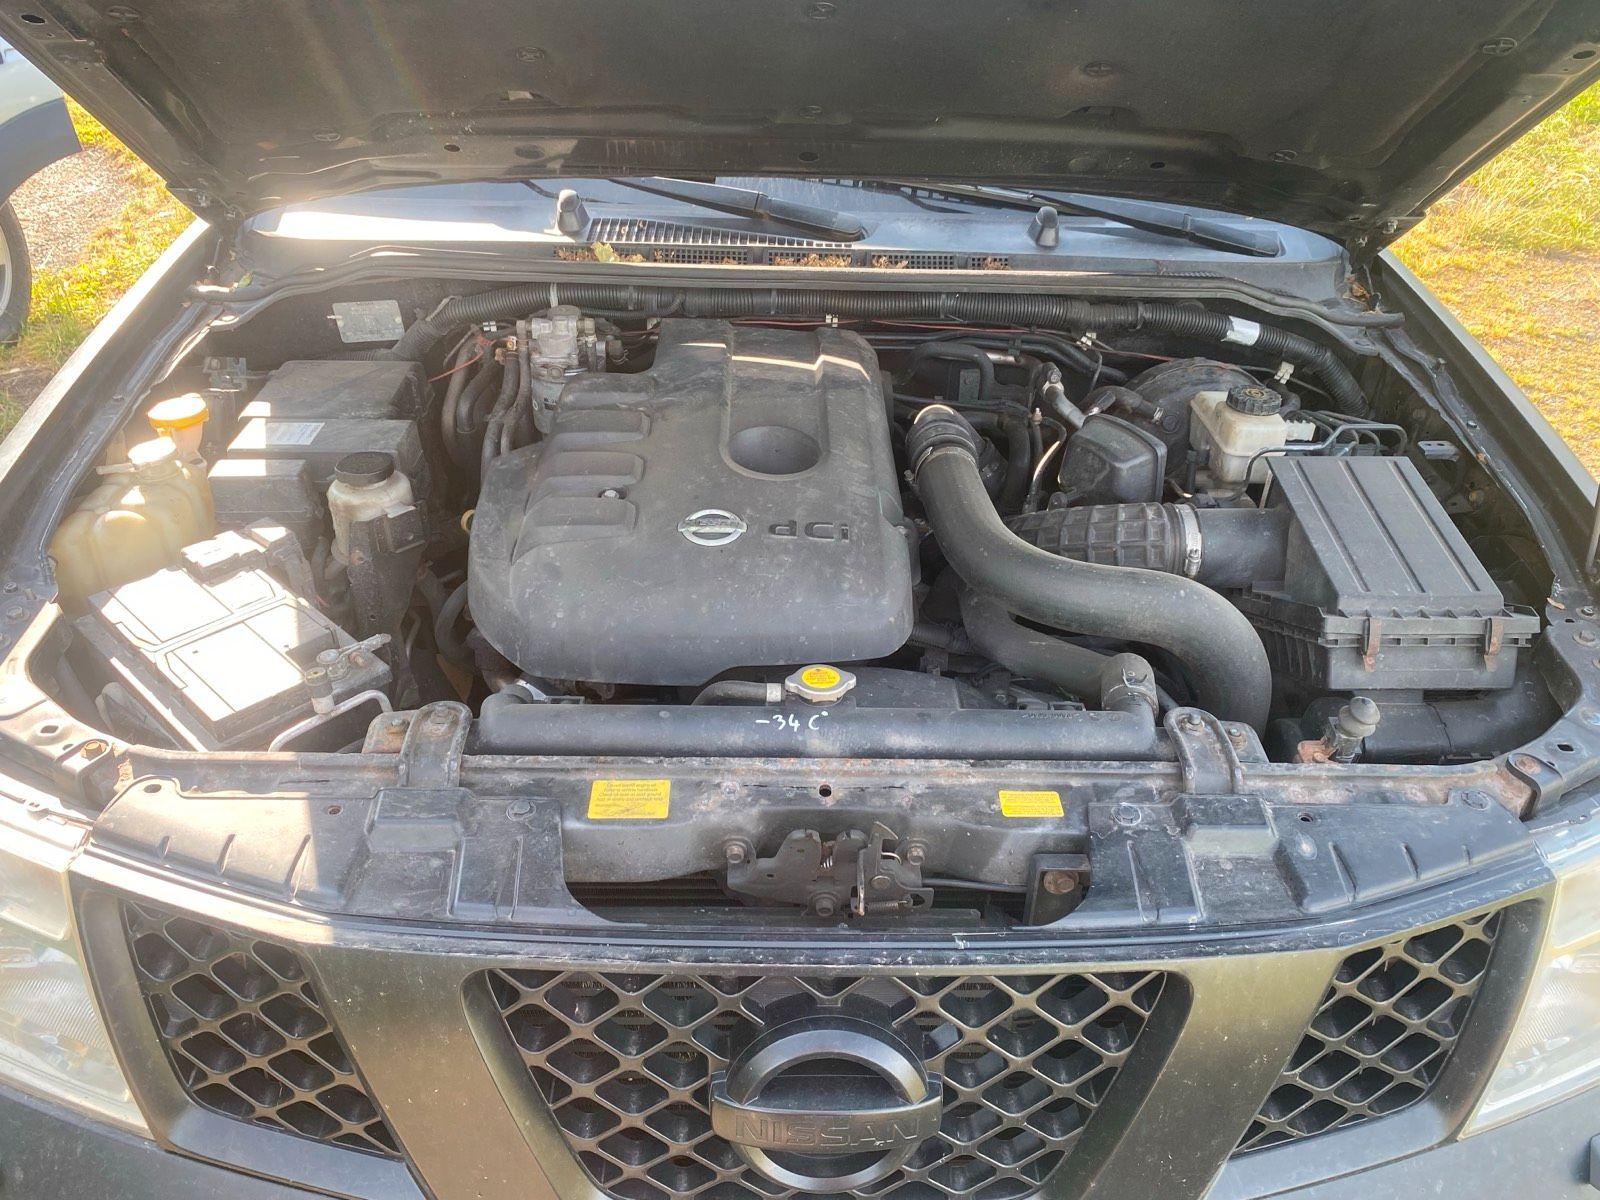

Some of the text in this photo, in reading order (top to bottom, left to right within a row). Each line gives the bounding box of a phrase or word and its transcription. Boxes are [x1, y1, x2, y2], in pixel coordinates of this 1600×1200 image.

[768, 520, 849, 541] dCi
[755, 714, 800, 732] -34
[735, 1116, 921, 1147] NISSAN
